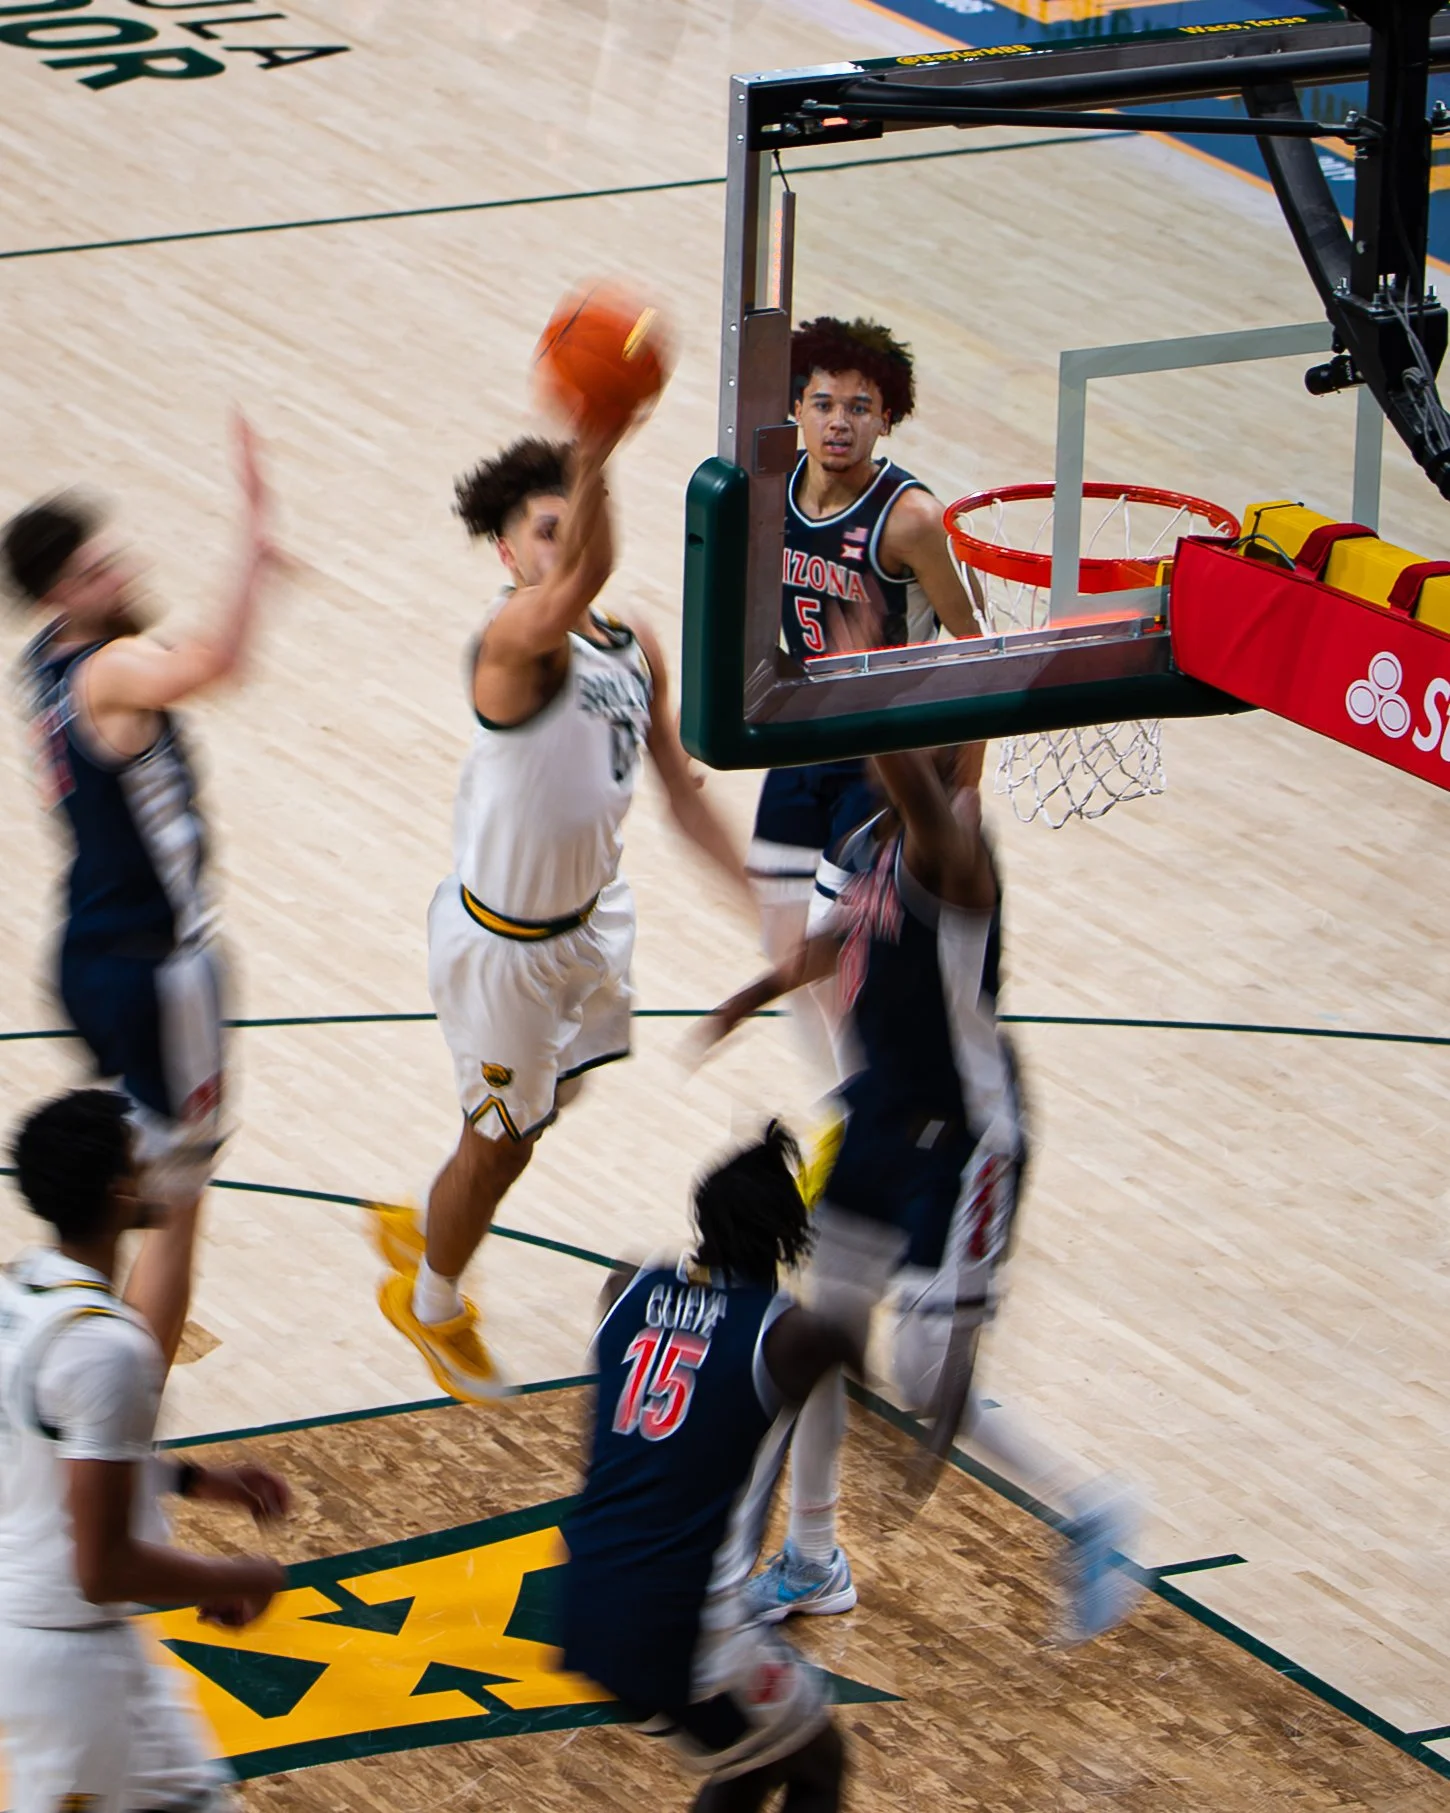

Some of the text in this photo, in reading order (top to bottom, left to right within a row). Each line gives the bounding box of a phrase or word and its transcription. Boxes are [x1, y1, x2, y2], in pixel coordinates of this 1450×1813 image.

[1178, 16, 1307, 34] Waco, Texas
[896, 44, 1032, 65] @BaylorMBB
[794, 595, 826, 653] 5
[611, 1327, 712, 1441] 15
